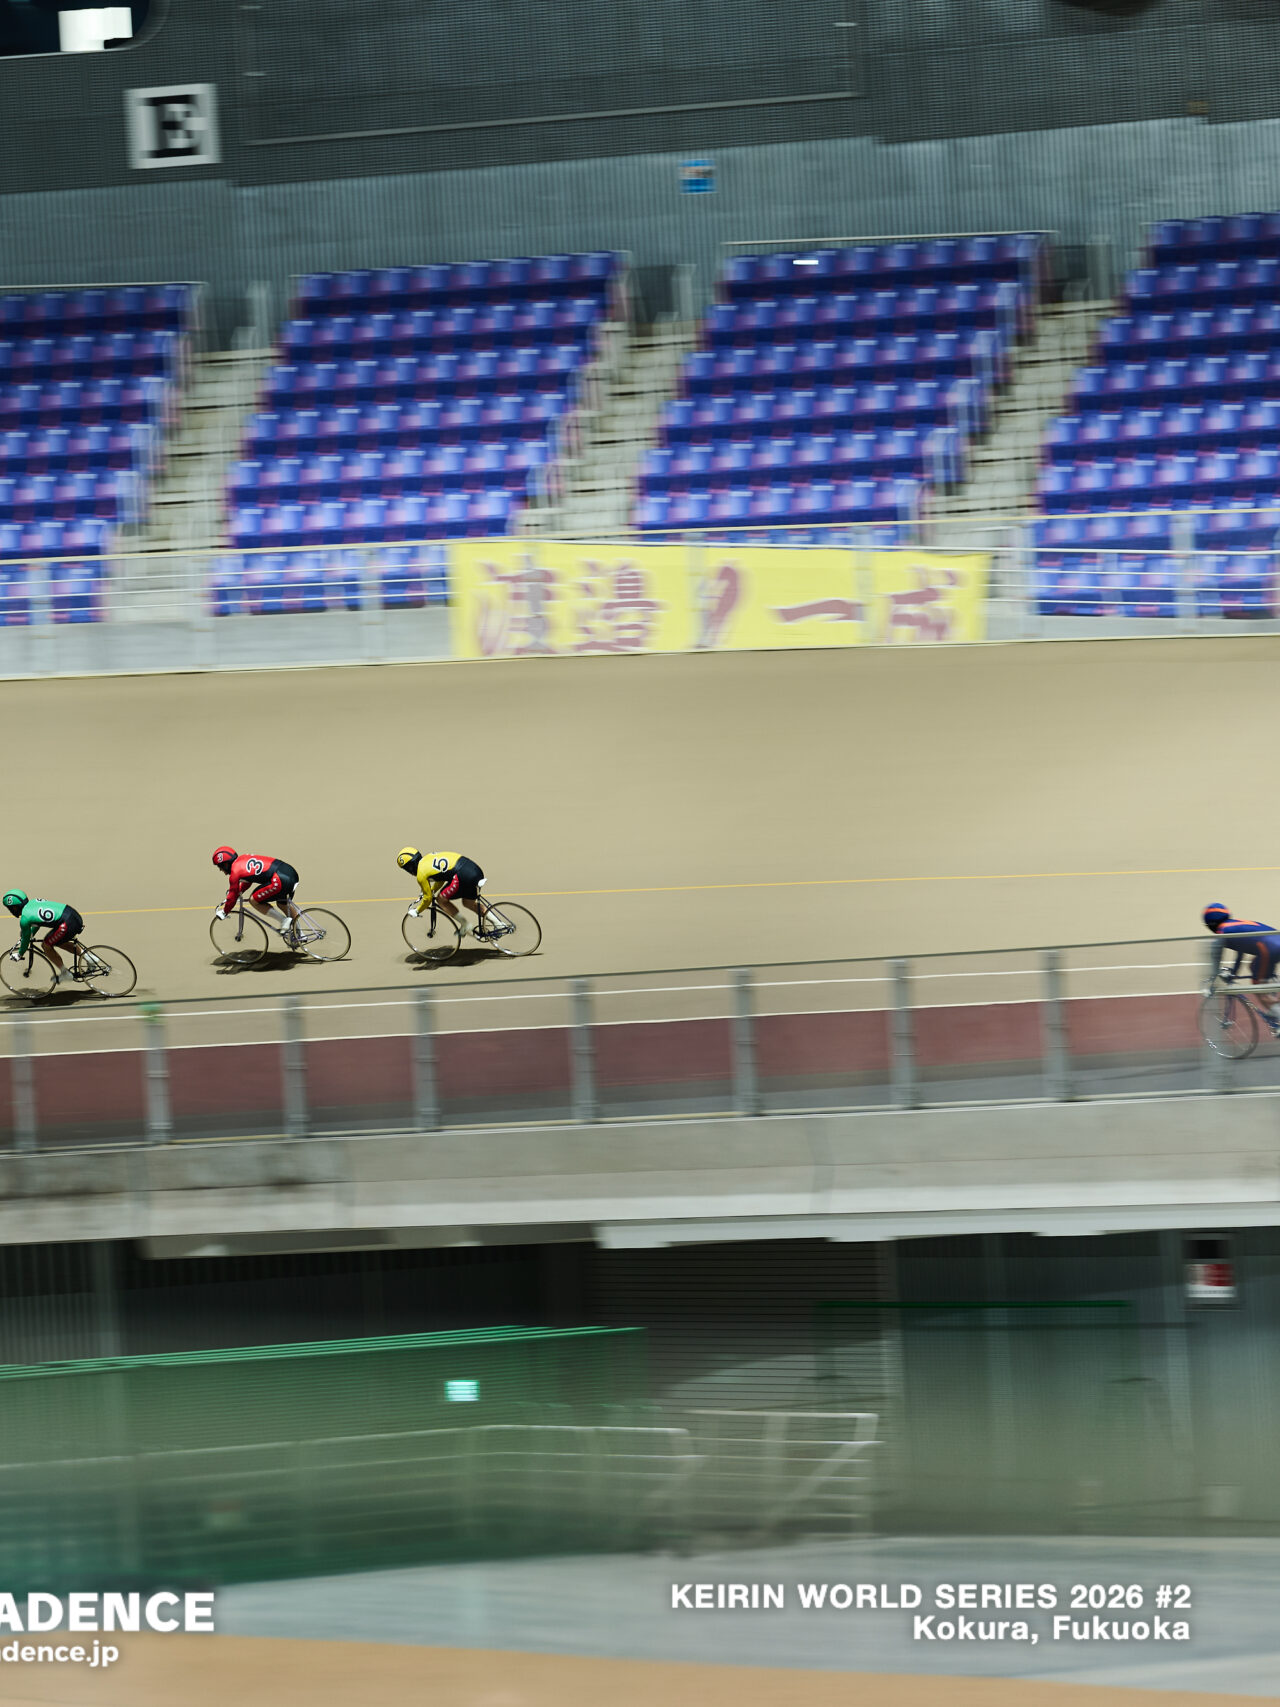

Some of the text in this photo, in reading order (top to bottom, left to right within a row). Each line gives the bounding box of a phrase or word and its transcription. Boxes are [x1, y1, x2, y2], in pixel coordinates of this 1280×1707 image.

[136, 94, 202, 159] E
[246, 858, 264, 875] 3
[432, 858, 449, 873] 5
[38, 907, 55, 922] 6
